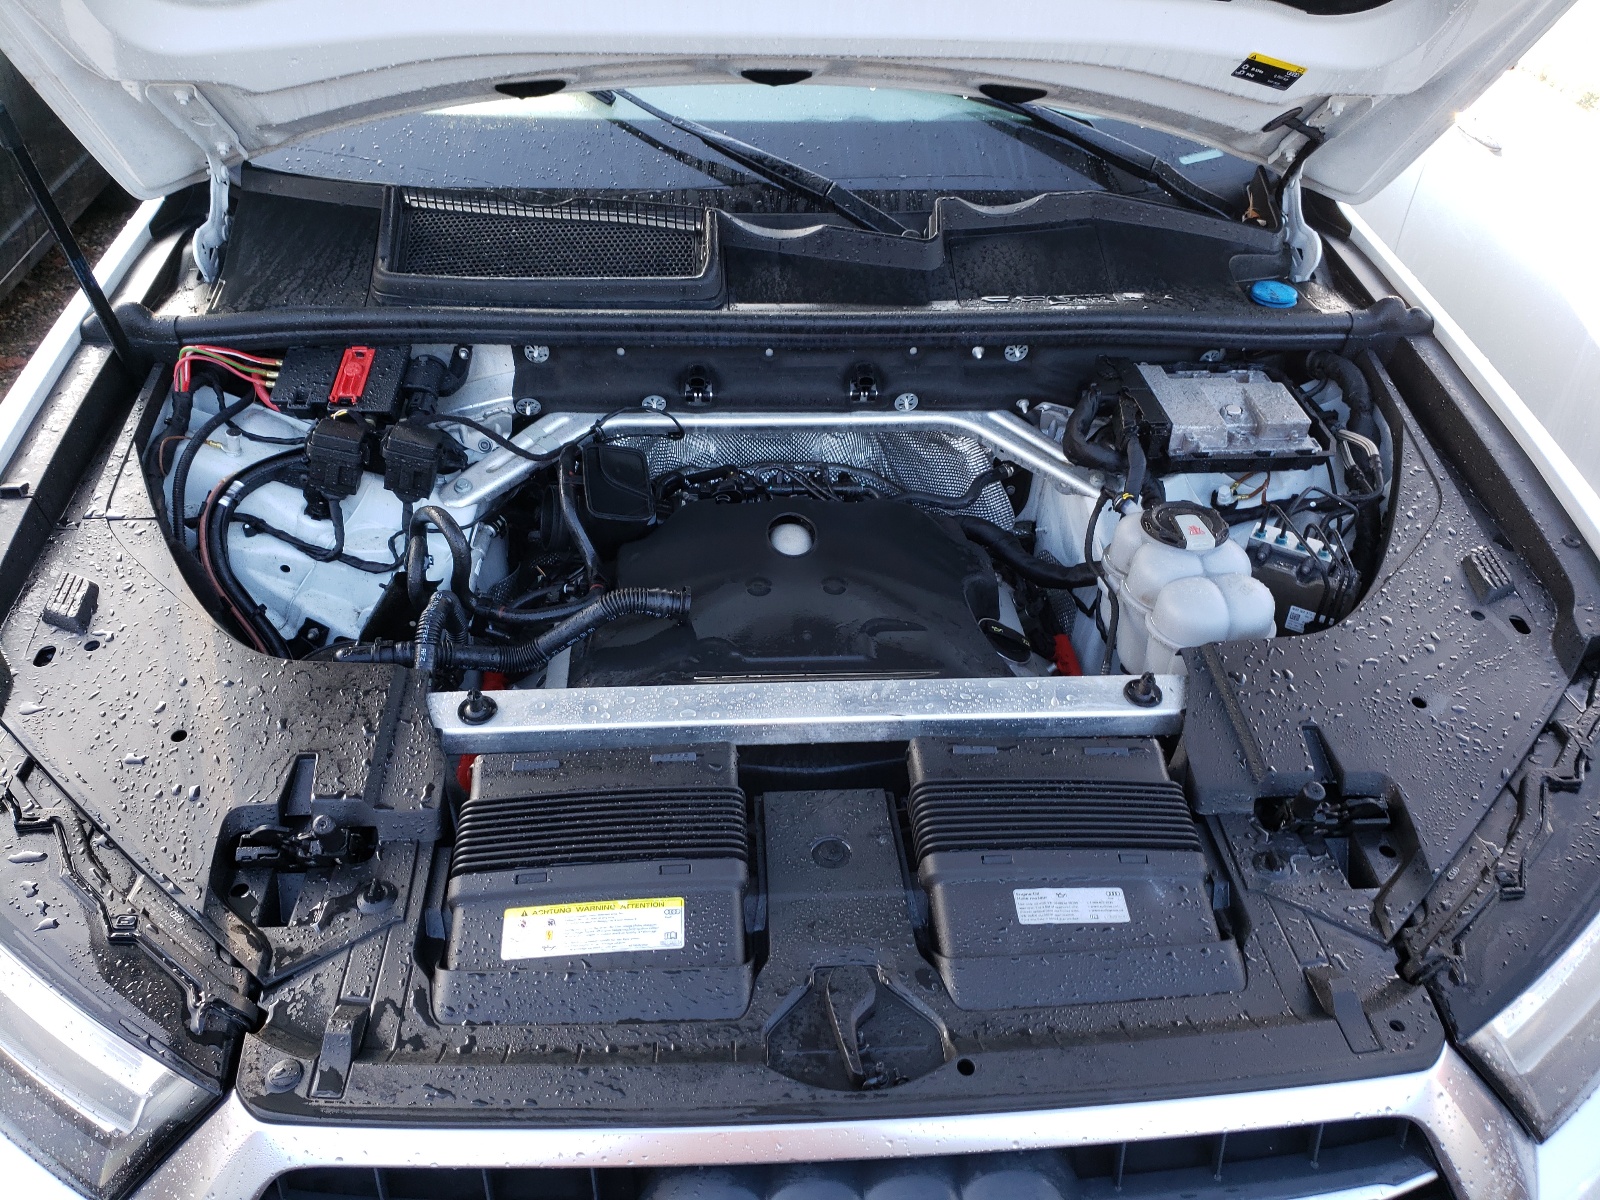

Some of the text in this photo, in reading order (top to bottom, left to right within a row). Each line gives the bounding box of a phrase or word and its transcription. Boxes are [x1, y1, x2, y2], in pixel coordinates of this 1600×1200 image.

[531, 901, 665, 916] ACHTUNG WARNING ATTENTION
